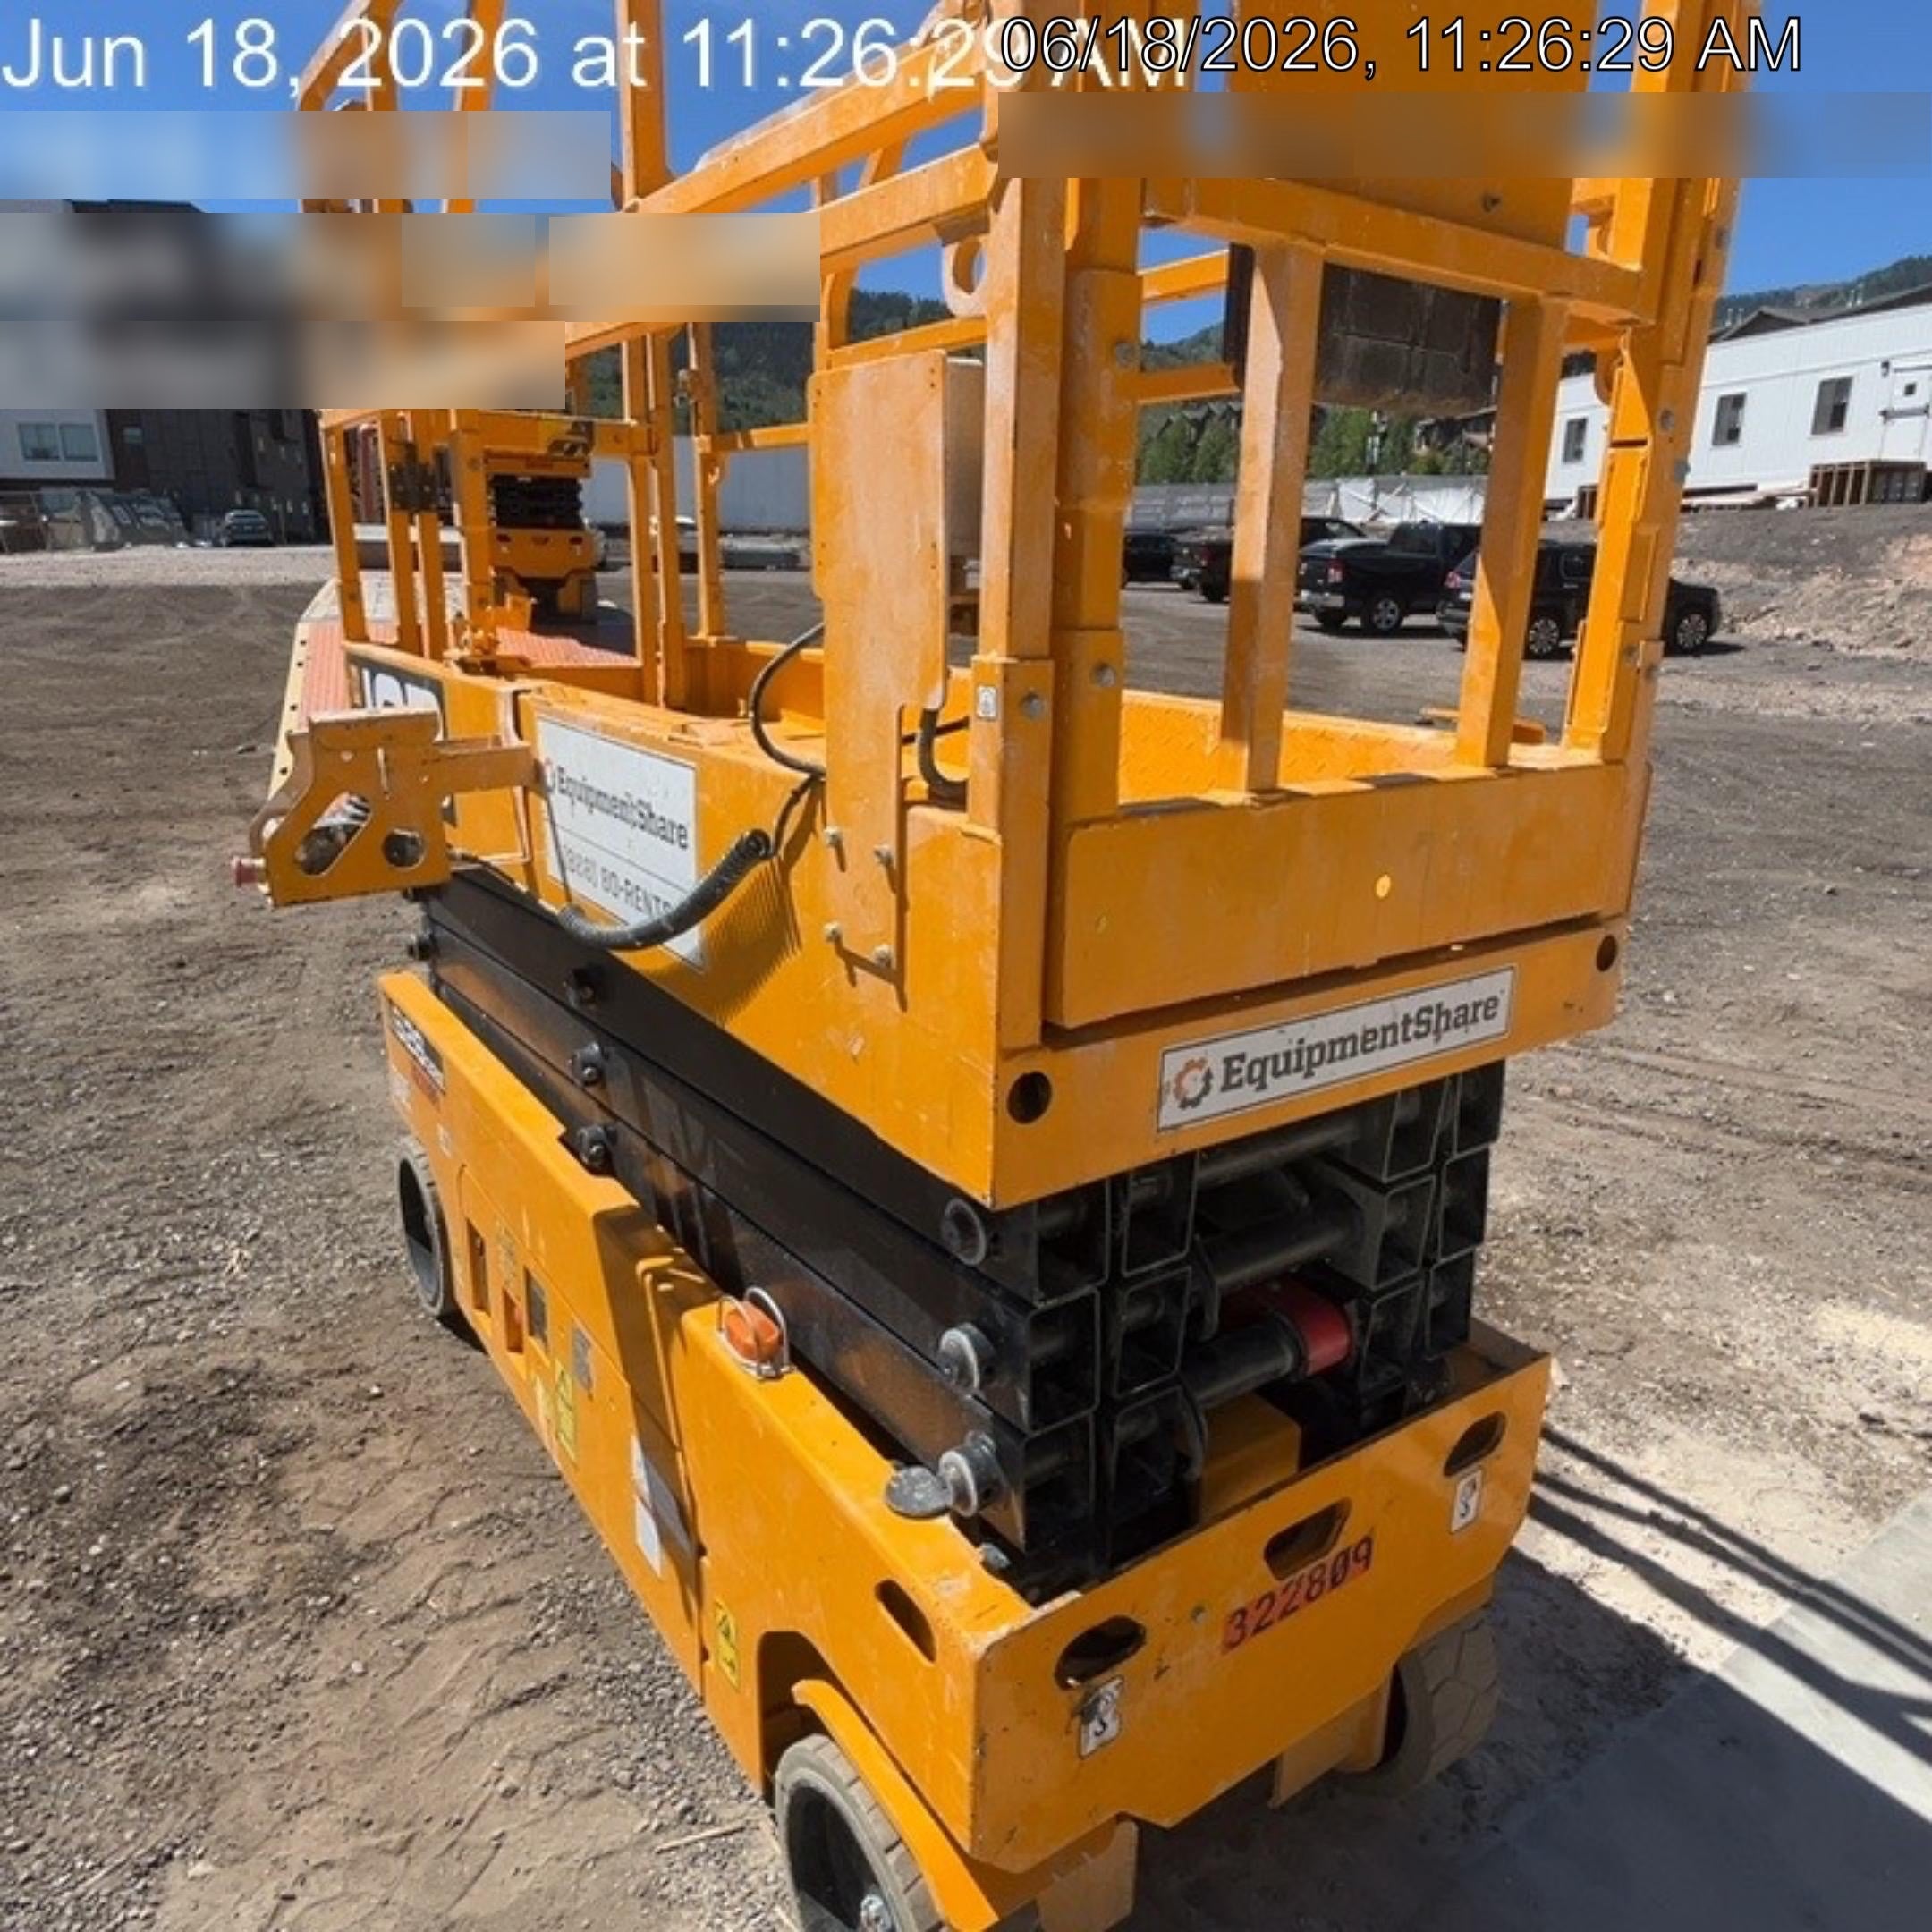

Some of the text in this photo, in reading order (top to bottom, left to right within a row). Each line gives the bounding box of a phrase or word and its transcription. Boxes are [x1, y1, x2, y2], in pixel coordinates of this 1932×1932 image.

[557, 765, 689, 851] EquipmentShare
[1220, 993, 1499, 1093] EquipmentShare
[1223, 1534, 1373, 1651] 322809
